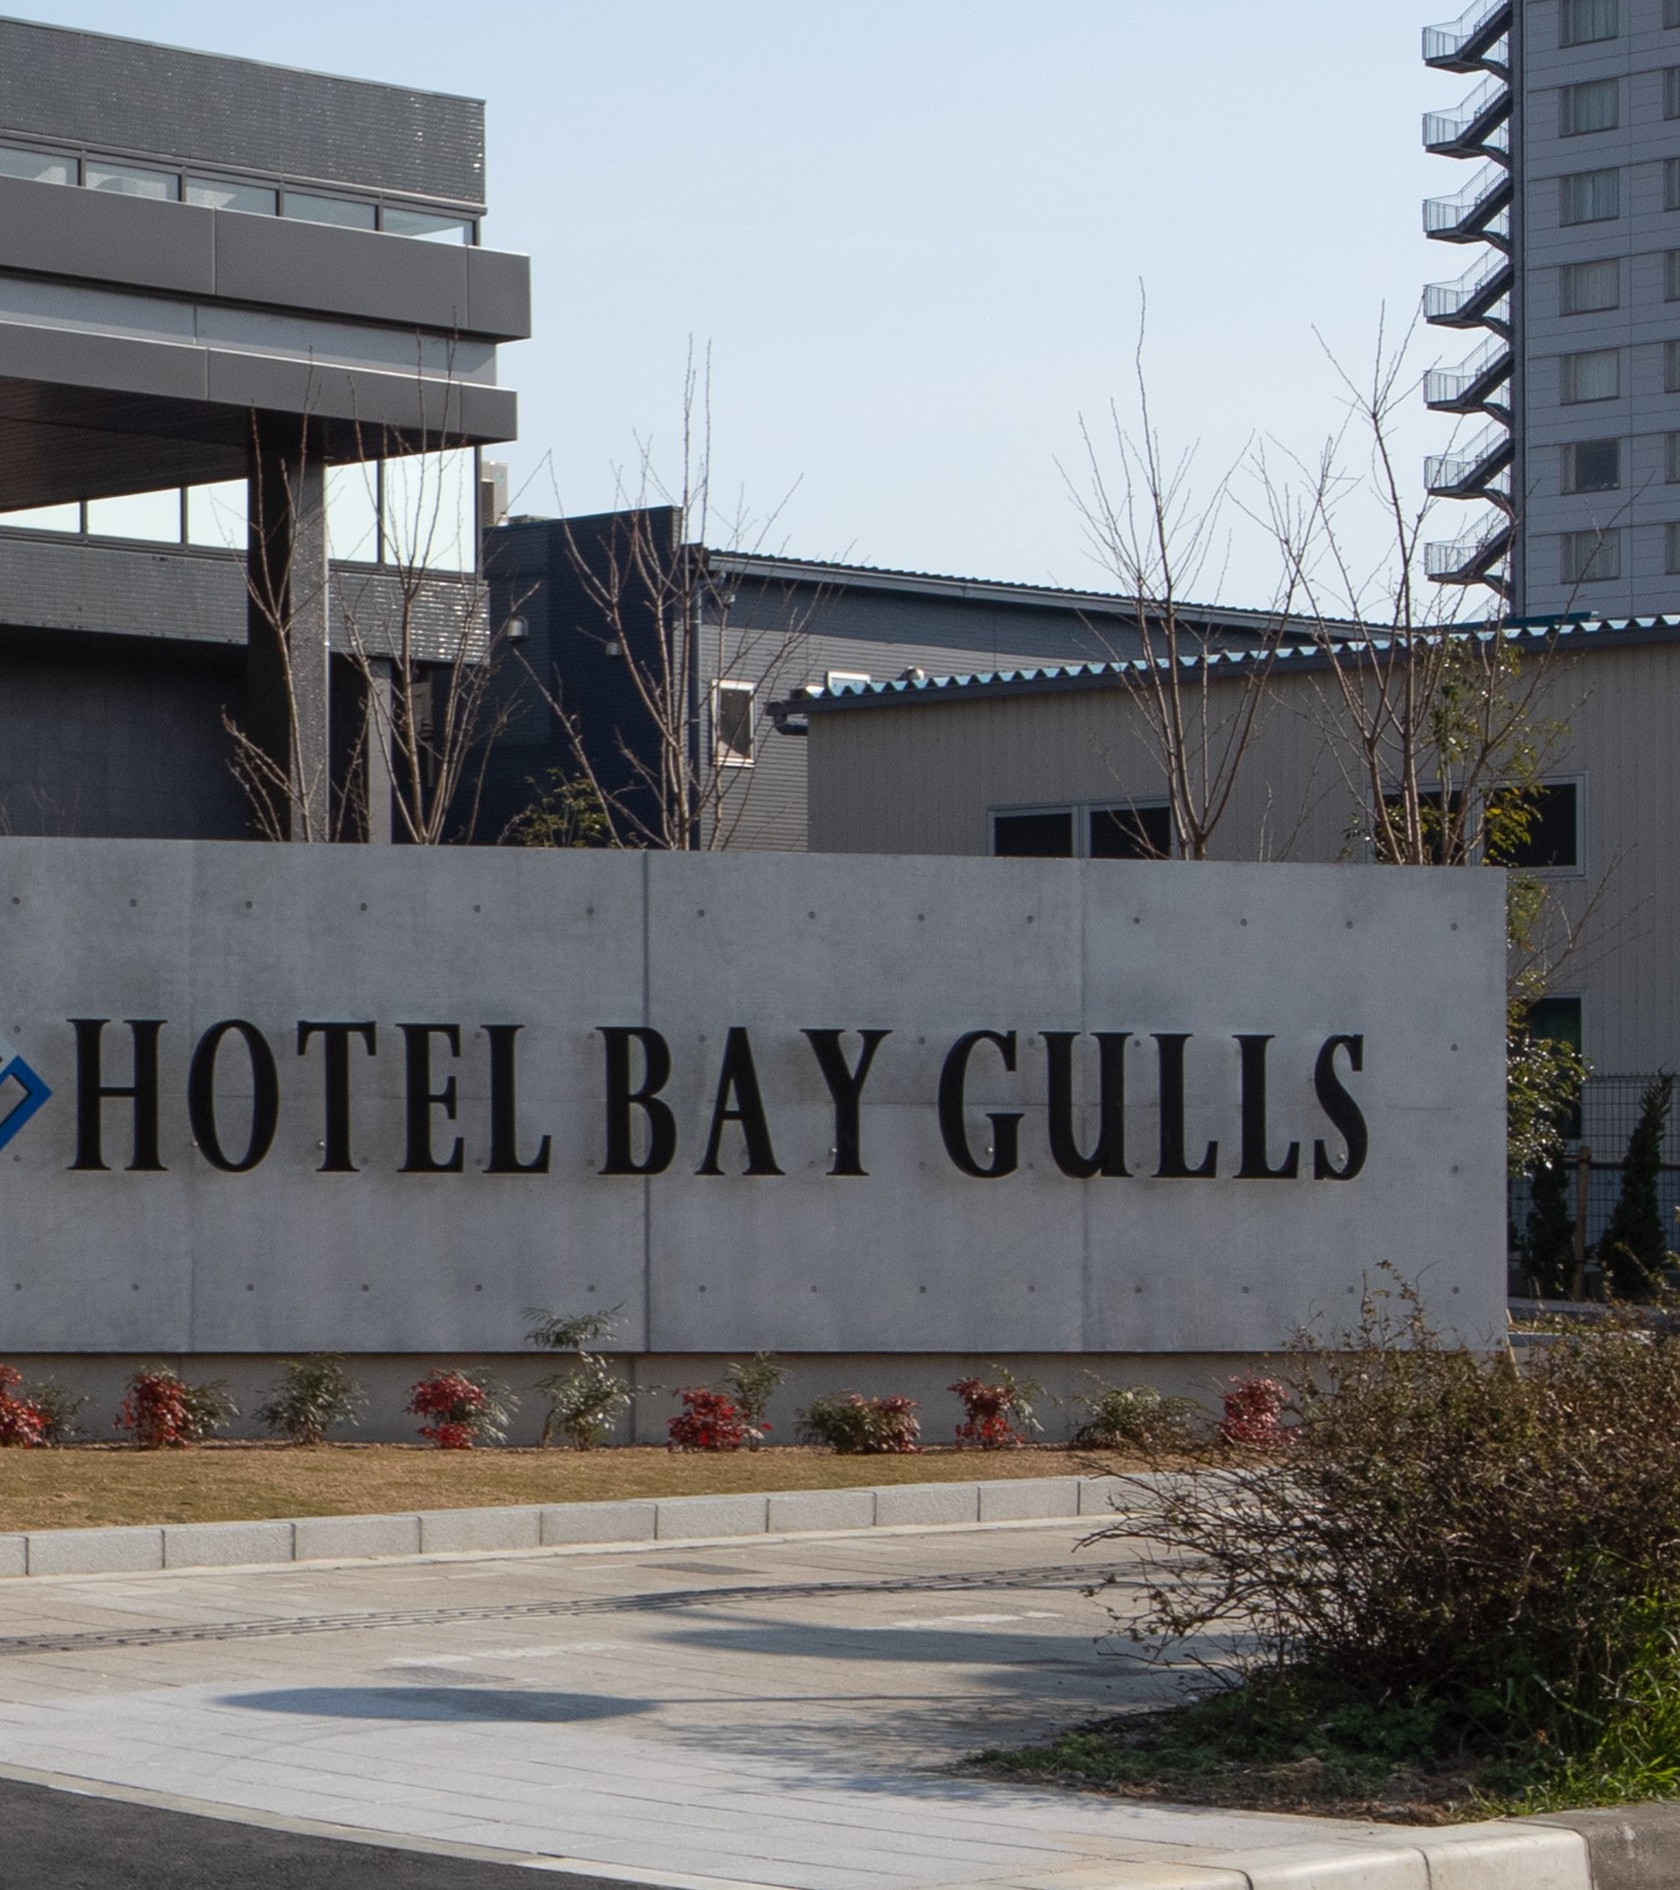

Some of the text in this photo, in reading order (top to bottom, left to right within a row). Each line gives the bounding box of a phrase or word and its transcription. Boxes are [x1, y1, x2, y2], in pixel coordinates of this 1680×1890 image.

[65, 1017, 1368, 1181] HOTEL BAY GULLS
